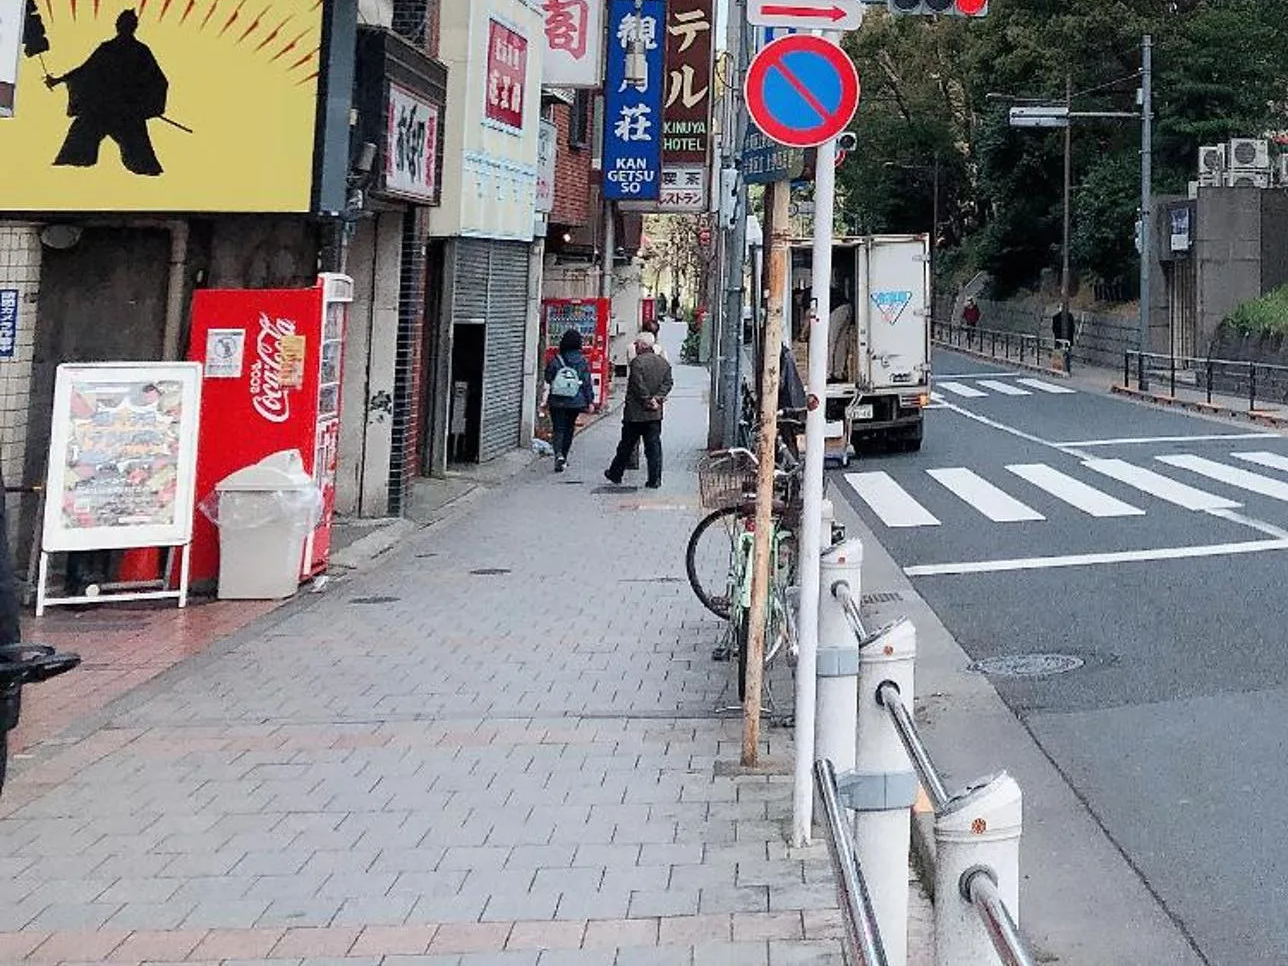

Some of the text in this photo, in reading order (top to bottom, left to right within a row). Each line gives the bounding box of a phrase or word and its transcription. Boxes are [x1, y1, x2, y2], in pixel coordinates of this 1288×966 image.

[663, 121, 706, 134] KINUYA
[663, 137, 705, 151] HOTEL
[616, 158, 647, 169] KAN
[607, 170, 655, 182] GETSU
[621, 182, 641, 193] SO
